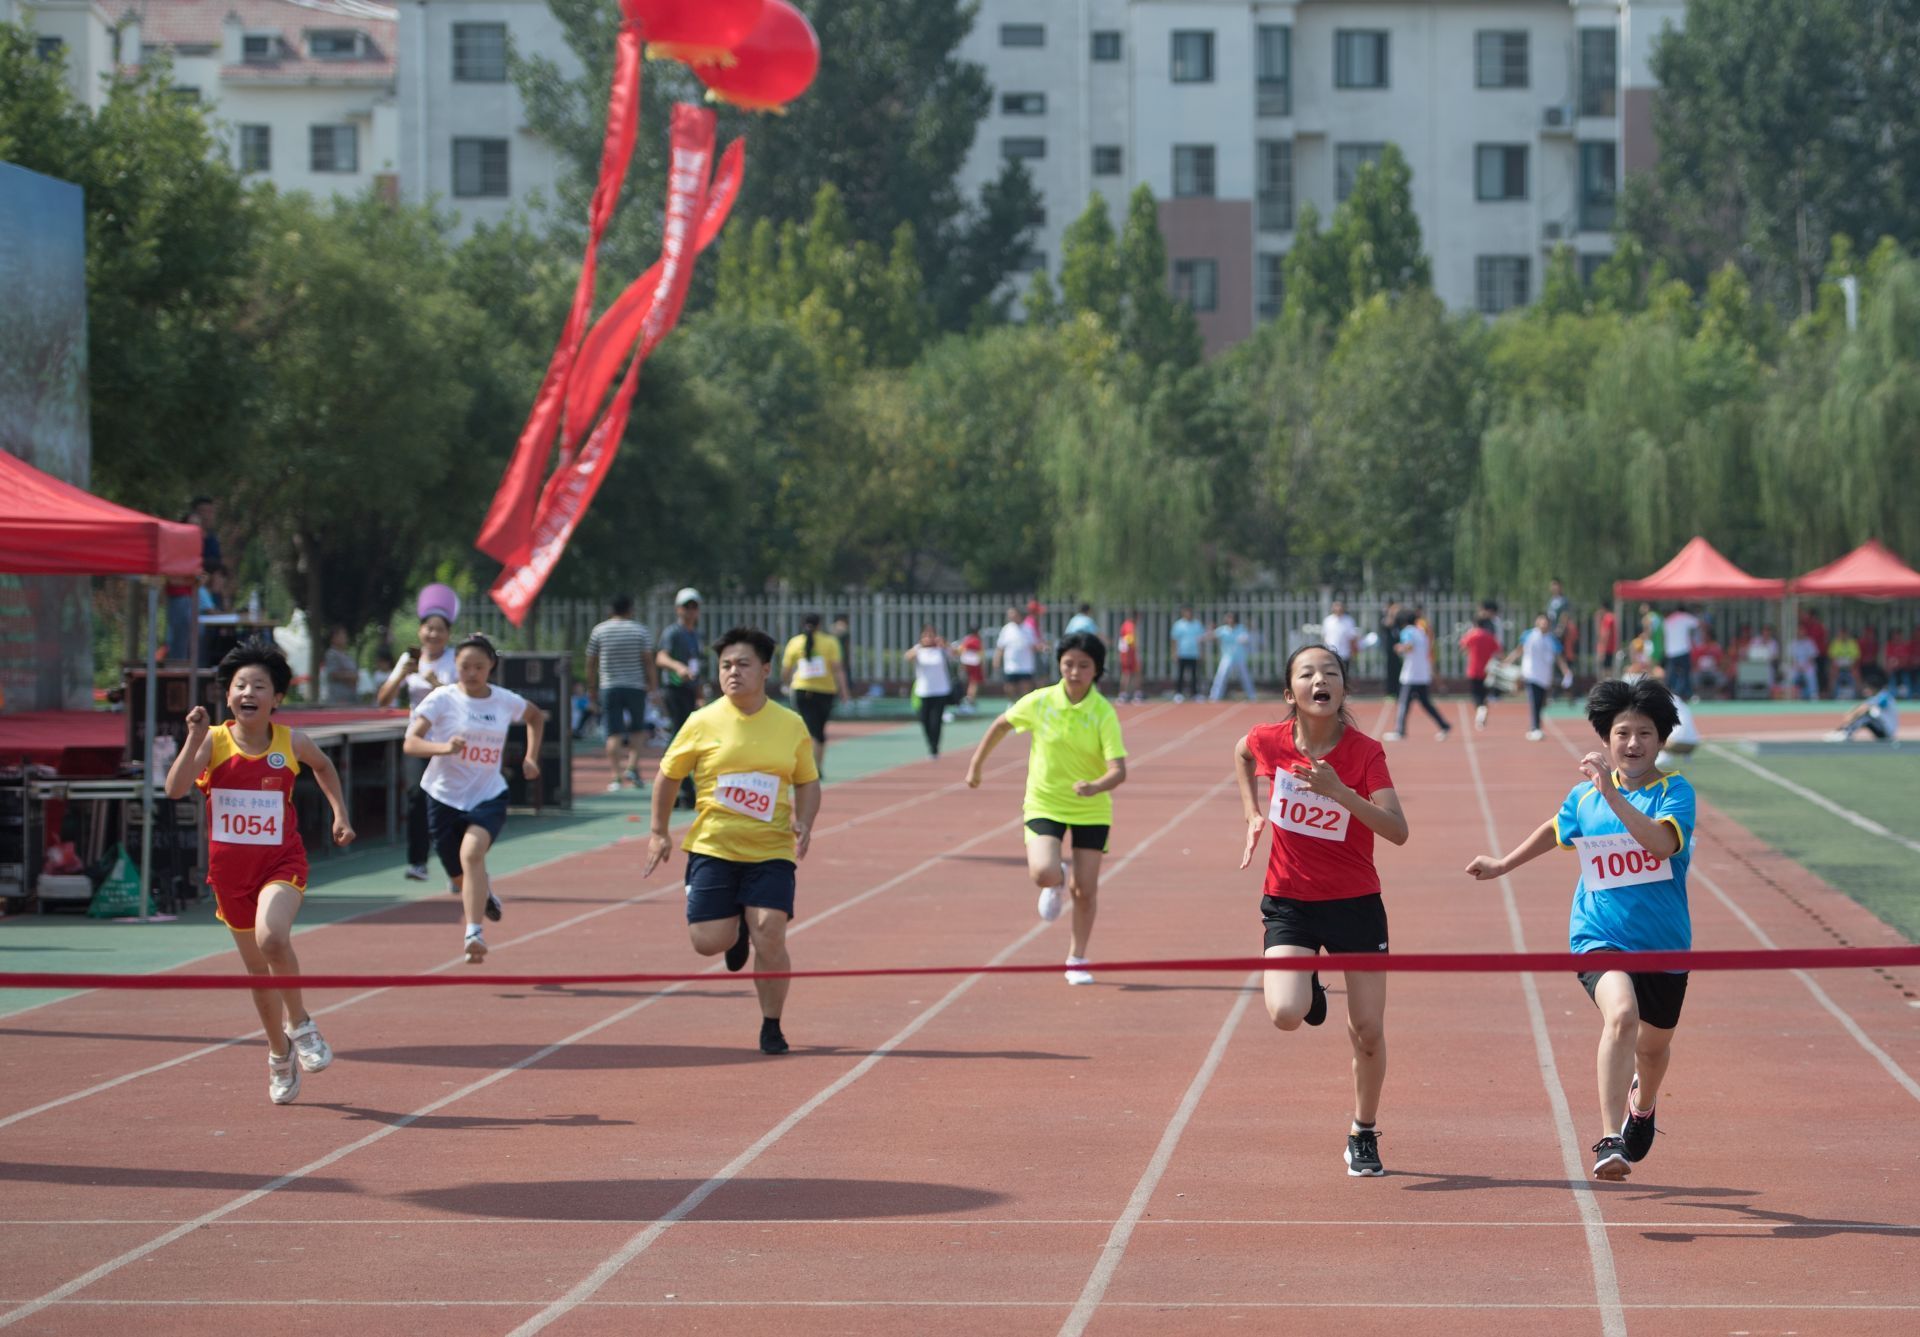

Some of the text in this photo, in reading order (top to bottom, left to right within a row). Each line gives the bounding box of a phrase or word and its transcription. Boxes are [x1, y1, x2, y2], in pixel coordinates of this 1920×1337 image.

[461, 745, 500, 765] 1033
[724, 786, 770, 813] 1029
[220, 813, 277, 836] 1054
[1279, 798, 1342, 832] 1022
[1591, 850, 1662, 880] 1005
